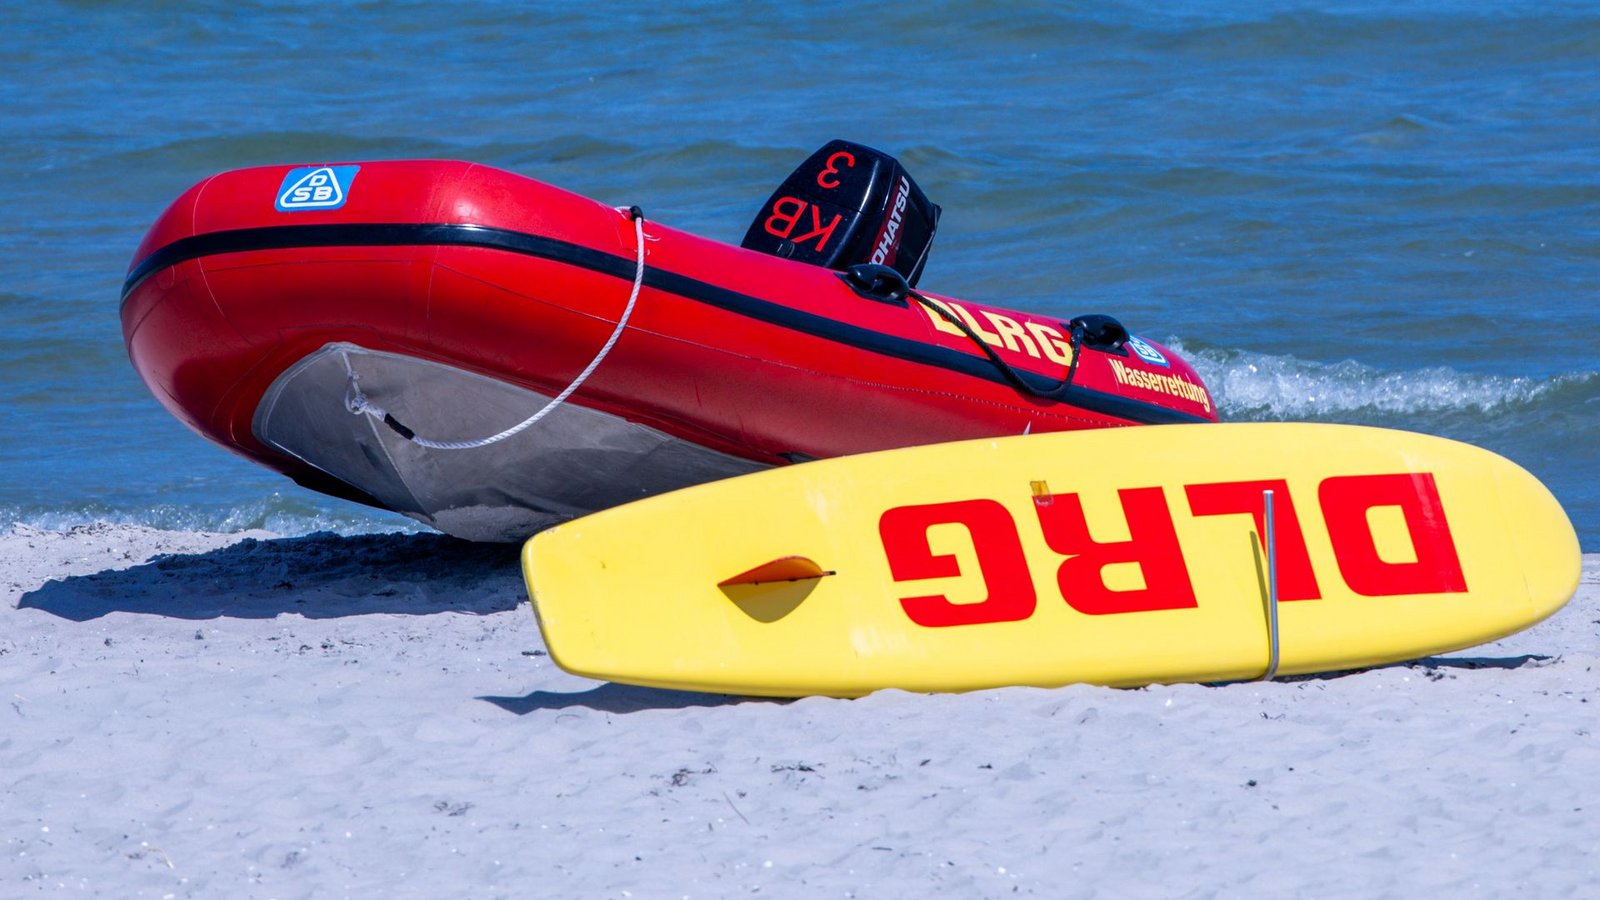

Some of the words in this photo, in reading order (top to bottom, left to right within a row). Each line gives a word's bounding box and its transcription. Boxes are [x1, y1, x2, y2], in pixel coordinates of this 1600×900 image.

[817, 151, 855, 189] 3
[764, 196, 842, 252] KB
[868, 175, 910, 266] OHATSU
[1108, 358, 1210, 412] Wasserrettung
[879, 472, 1468, 628] DLRG
